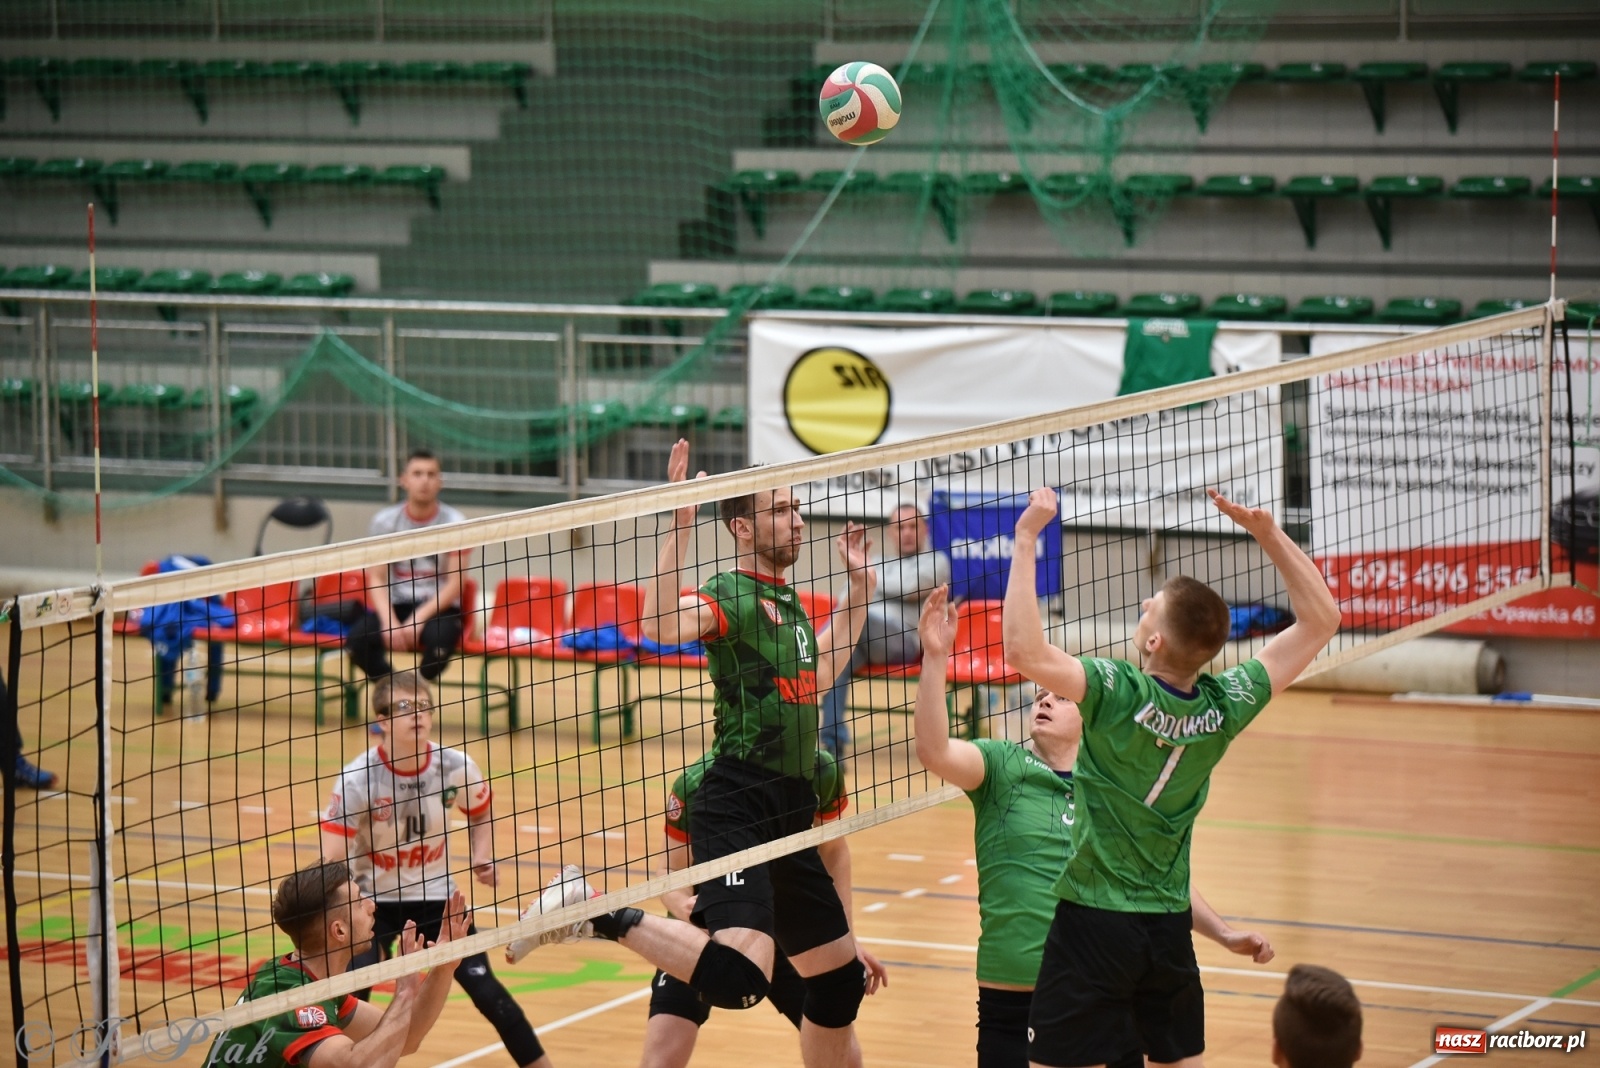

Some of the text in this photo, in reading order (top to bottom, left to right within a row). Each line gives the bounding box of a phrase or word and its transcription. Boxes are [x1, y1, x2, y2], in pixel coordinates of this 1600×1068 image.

[829, 111, 856, 127] molten
[1348, 558, 1407, 590] 695
[1414, 561, 1469, 594] 496
[1491, 604, 1570, 624] Opawska
[1143, 737, 1186, 808] 7
